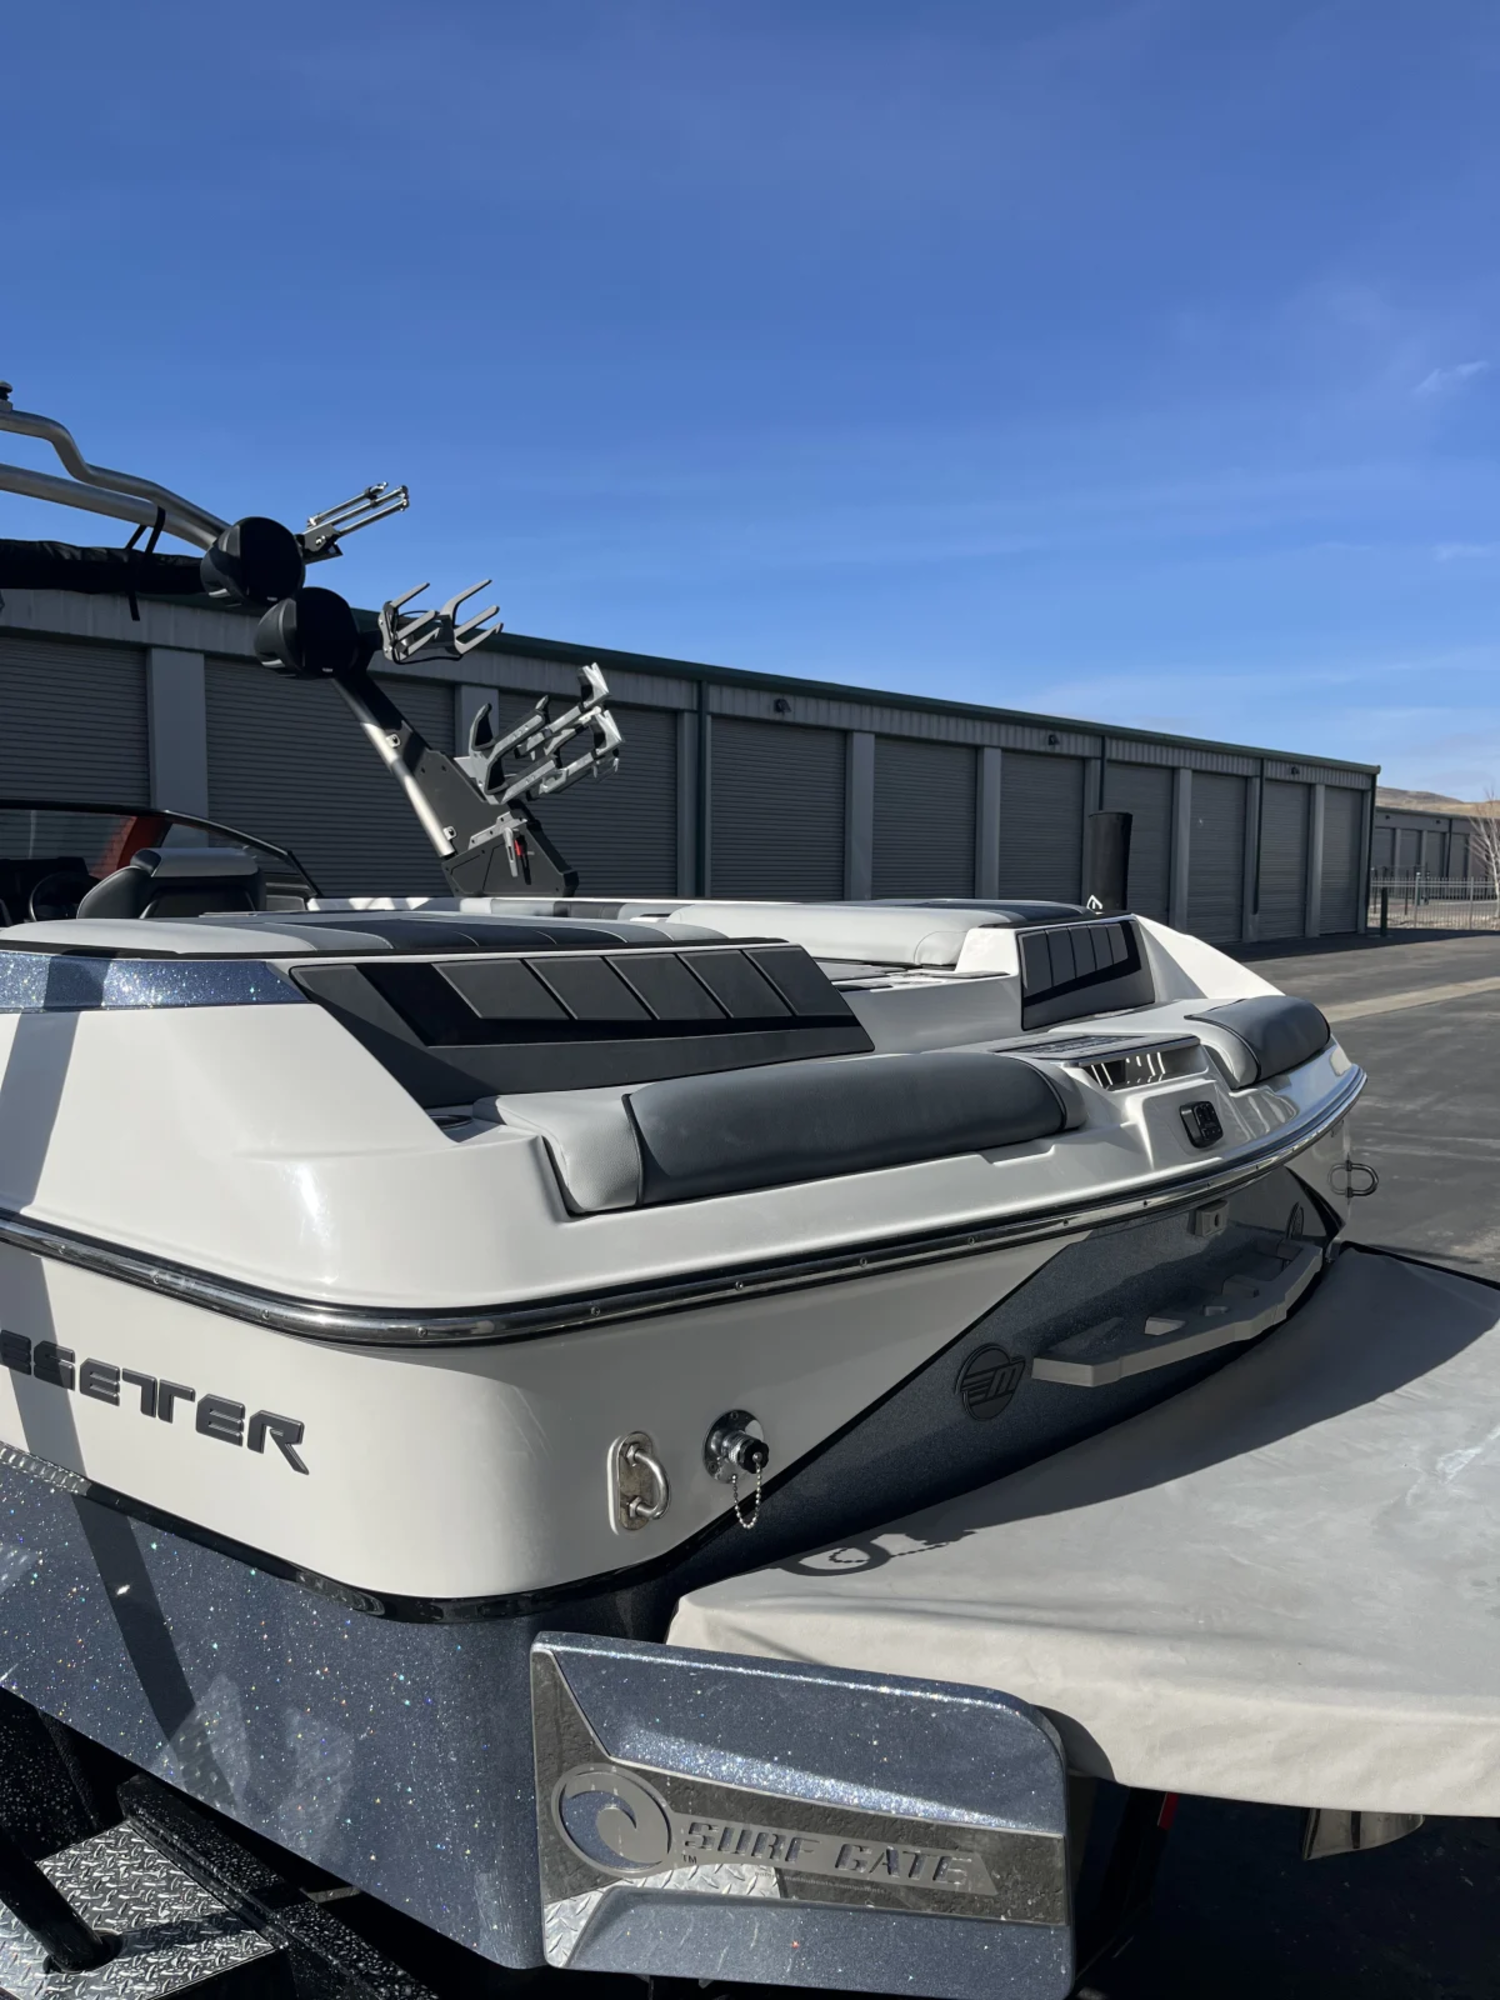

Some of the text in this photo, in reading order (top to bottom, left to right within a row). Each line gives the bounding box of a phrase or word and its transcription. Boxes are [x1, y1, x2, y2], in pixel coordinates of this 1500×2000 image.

[682, 1854, 697, 1864] TM
[684, 1821, 973, 1886] SURF GATE
